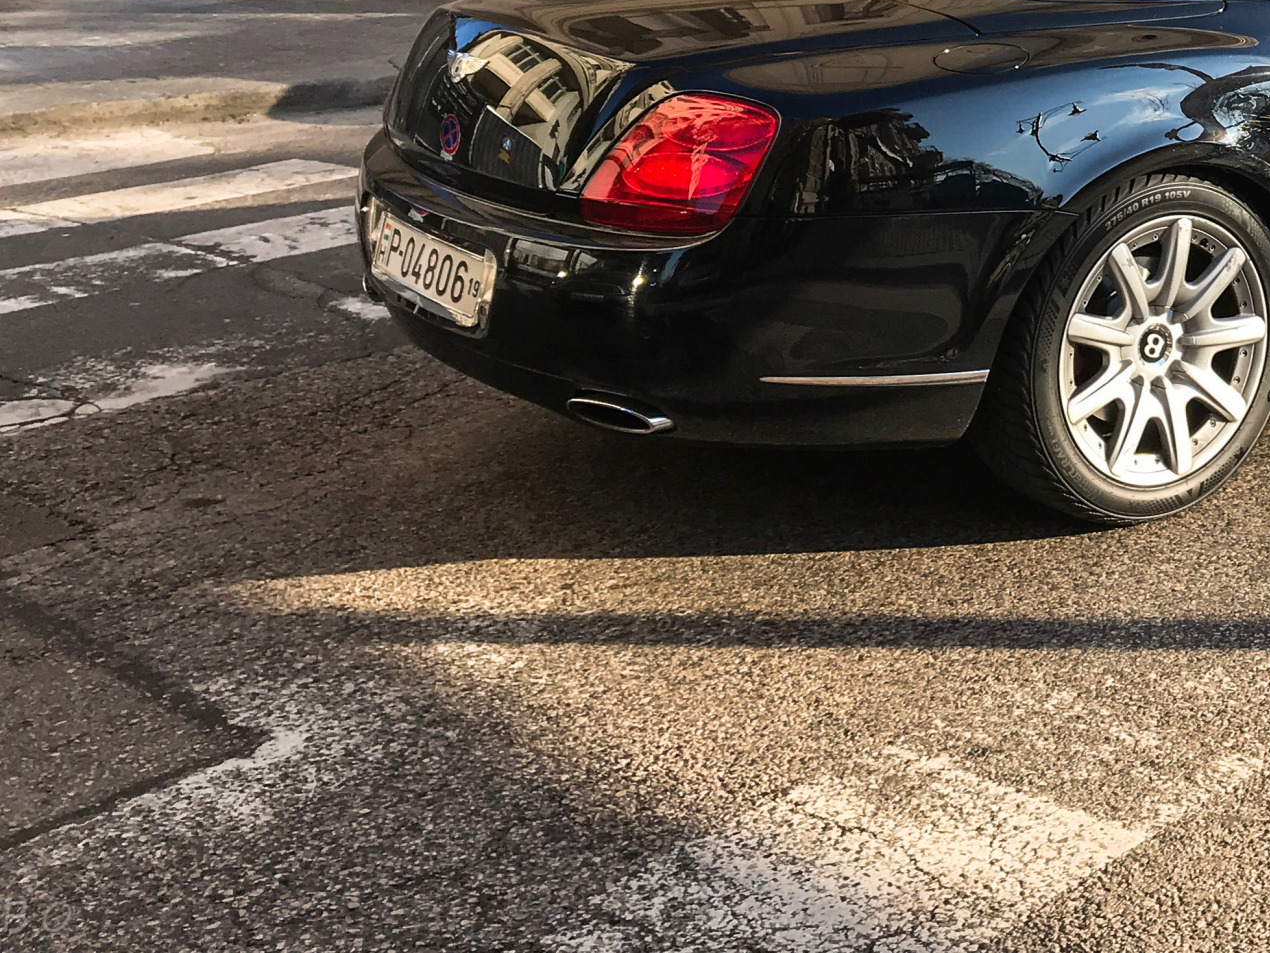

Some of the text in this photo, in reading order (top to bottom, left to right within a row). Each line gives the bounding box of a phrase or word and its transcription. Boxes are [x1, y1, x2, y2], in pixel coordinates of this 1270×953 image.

[1104, 190, 1192, 231] 275/40 R19 105V
